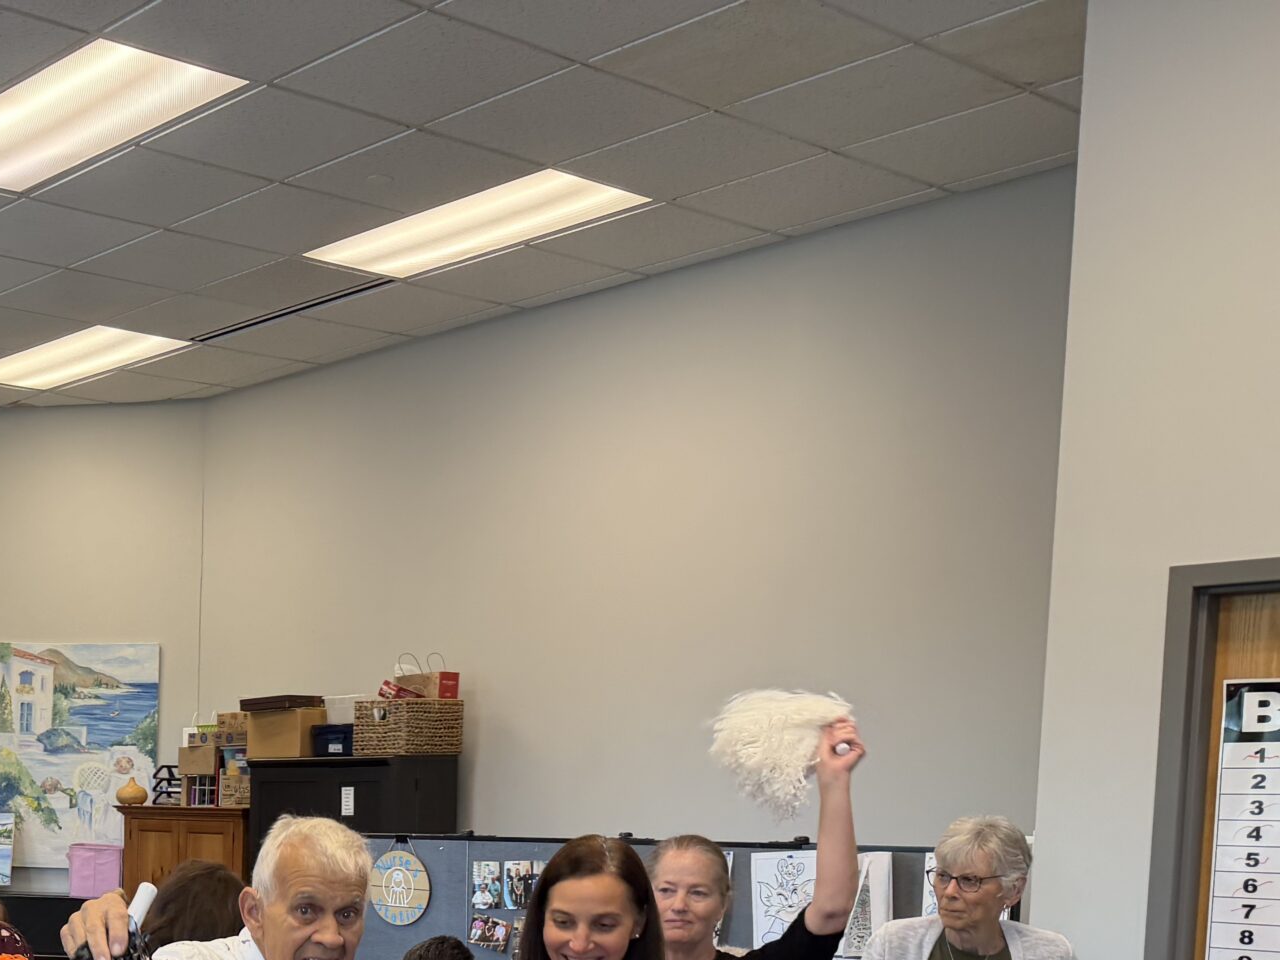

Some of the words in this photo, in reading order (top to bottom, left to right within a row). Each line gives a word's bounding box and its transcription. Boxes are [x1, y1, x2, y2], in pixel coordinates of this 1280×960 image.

[1242, 691, 1280, 733] B
[1254, 748, 1266, 763] 1
[1251, 774, 1266, 790] 2
[1249, 800, 1264, 816] 3
[1247, 826, 1262, 842] 4
[1245, 852, 1260, 868] 5
[1243, 878, 1258, 894] 6
[376, 898, 424, 922] Station
[1241, 904, 1257, 920] 7
[1239, 930, 1254, 945] 8
